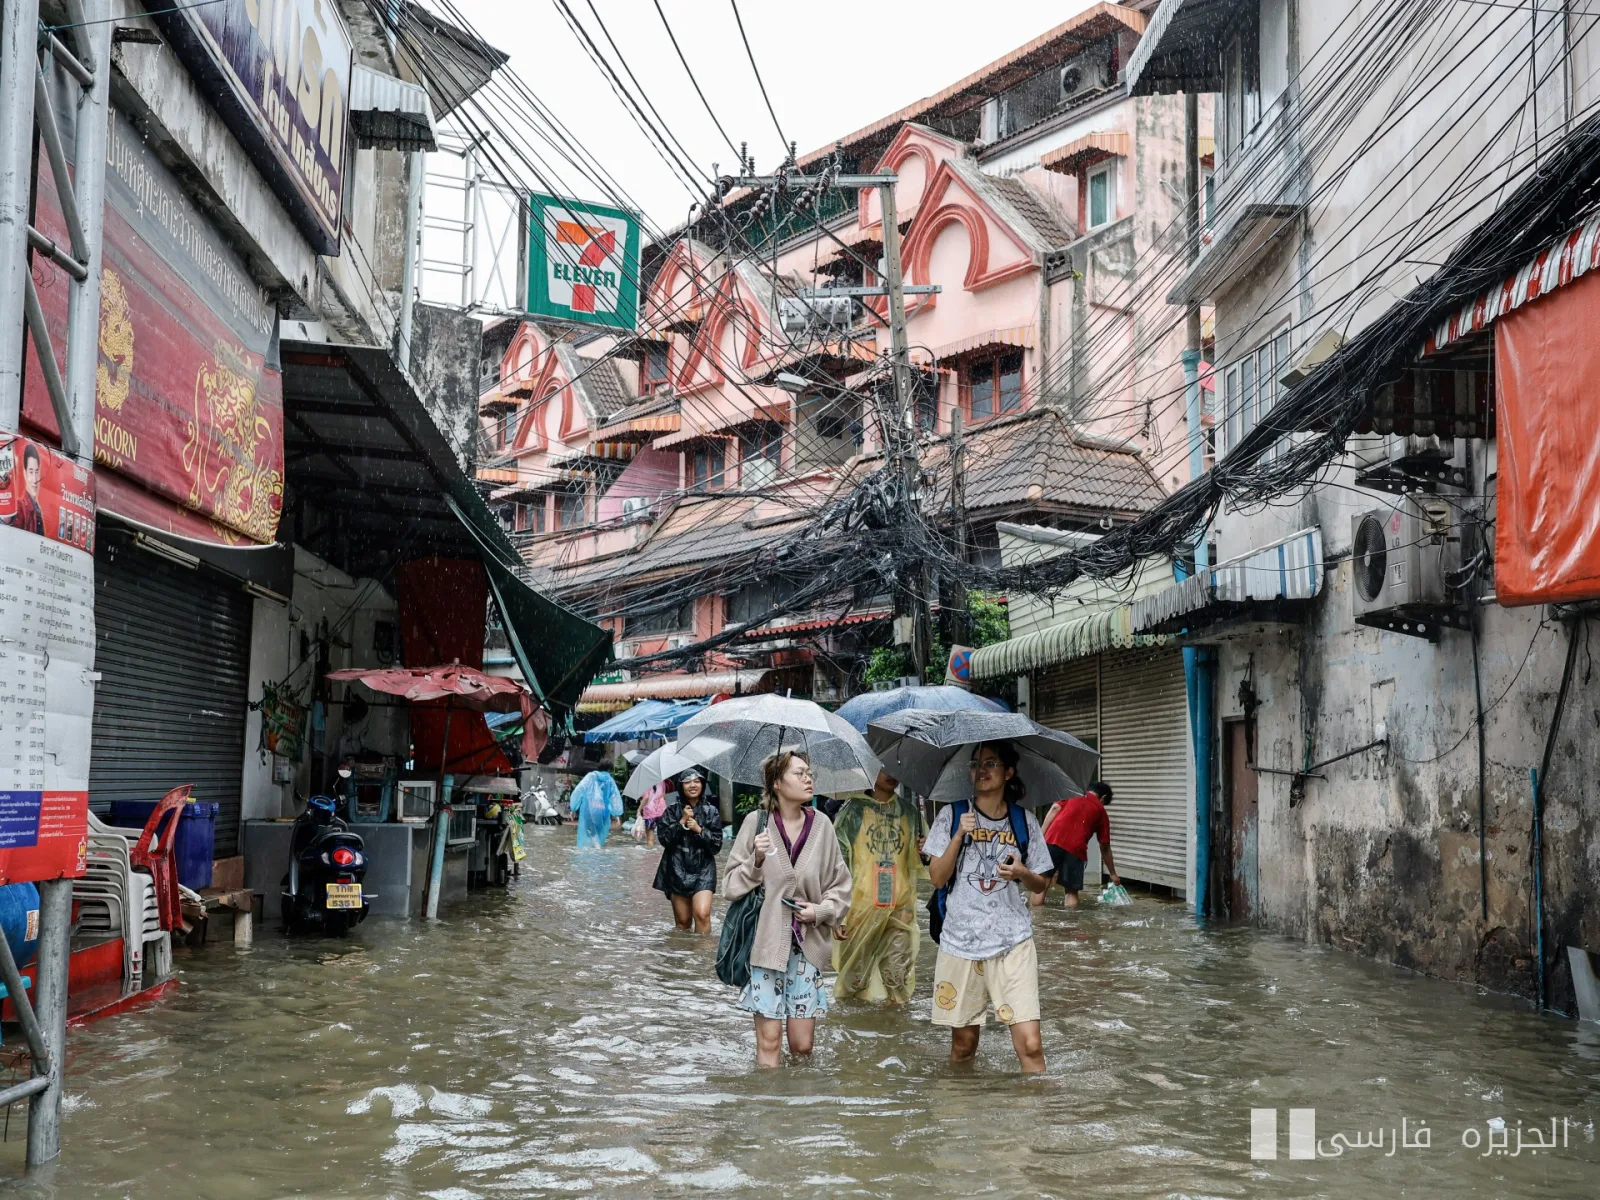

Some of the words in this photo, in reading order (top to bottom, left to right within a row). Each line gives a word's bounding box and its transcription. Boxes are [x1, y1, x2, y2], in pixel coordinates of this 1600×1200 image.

[1391, 537, 1400, 548] LG
[997, 831, 1017, 847] TU
[332, 899, 355, 907] 5351
